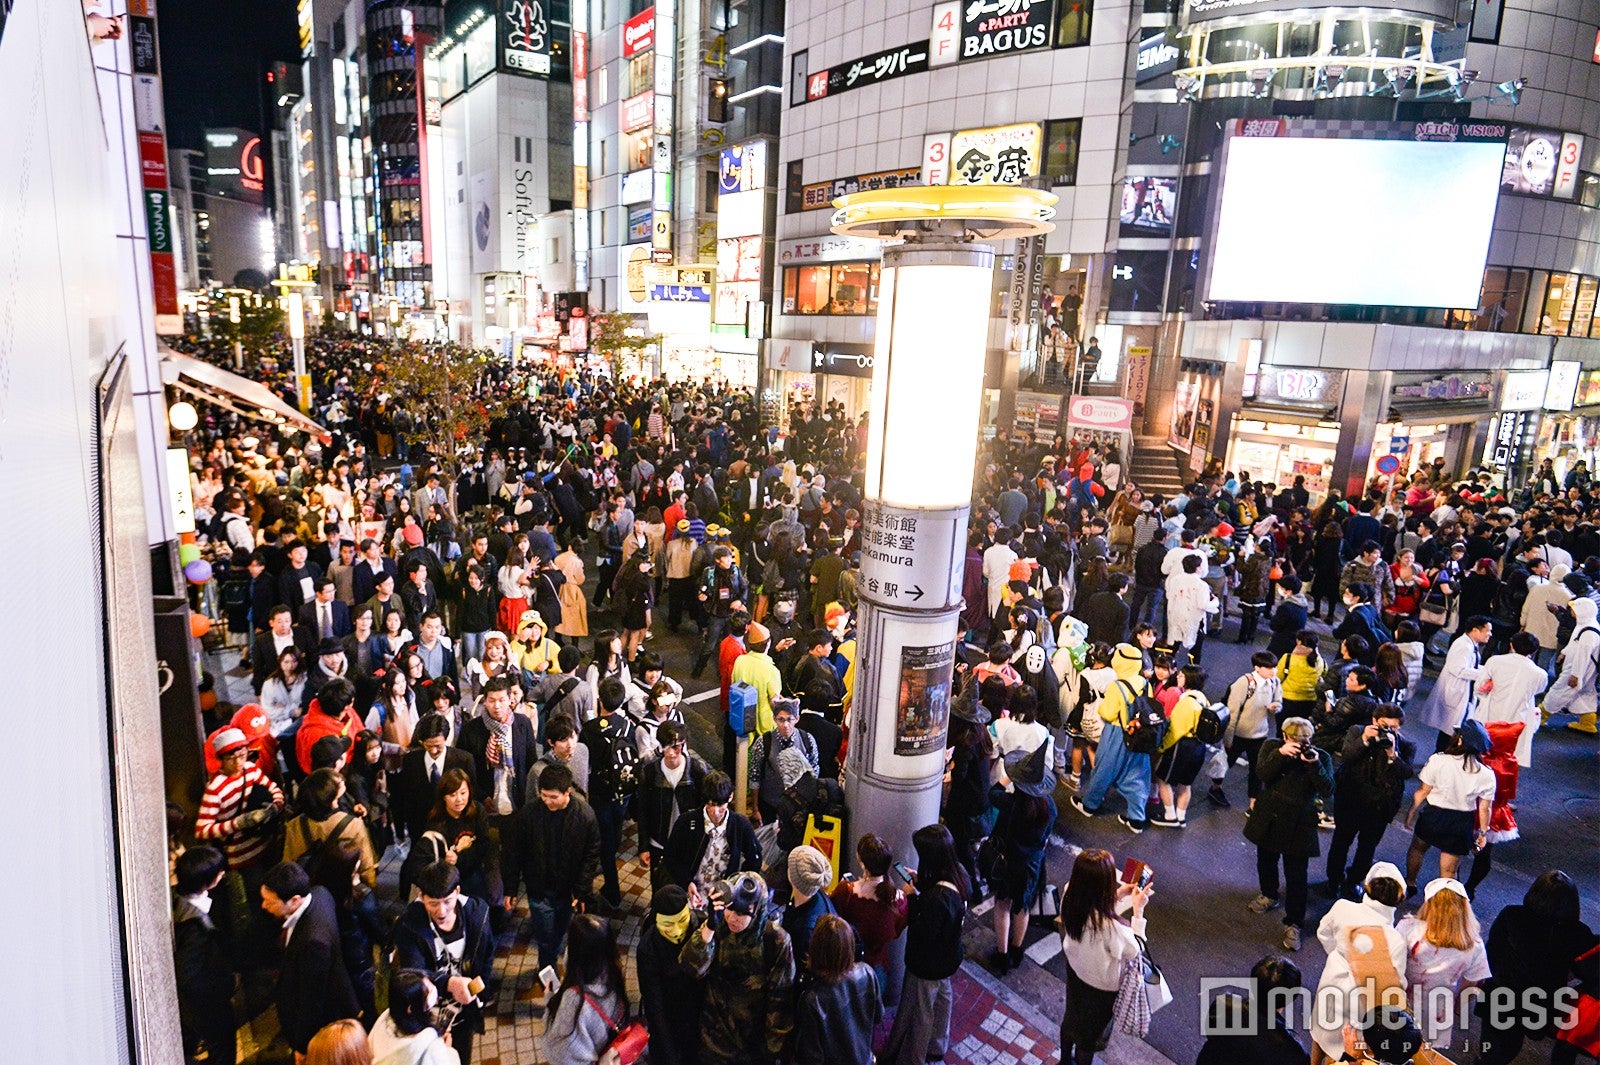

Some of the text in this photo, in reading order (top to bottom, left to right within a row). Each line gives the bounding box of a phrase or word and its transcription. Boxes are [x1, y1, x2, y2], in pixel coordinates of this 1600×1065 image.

[964, 24, 1046, 57] BAGUS
[847, 48, 927, 86] ダーツバー
[809, 75, 828, 97] 4F
[1244, 120, 1280, 136] 楽園
[1462, 125, 1506, 137] VISION
[956, 145, 1031, 183] 金の蔵
[1560, 142, 1578, 189] 3F
[1013, 254, 1026, 294] LOUIS
[1032, 255, 1043, 294] LOUIS
[1011, 299, 1022, 325] BLD
[1029, 300, 1039, 325] BLD
